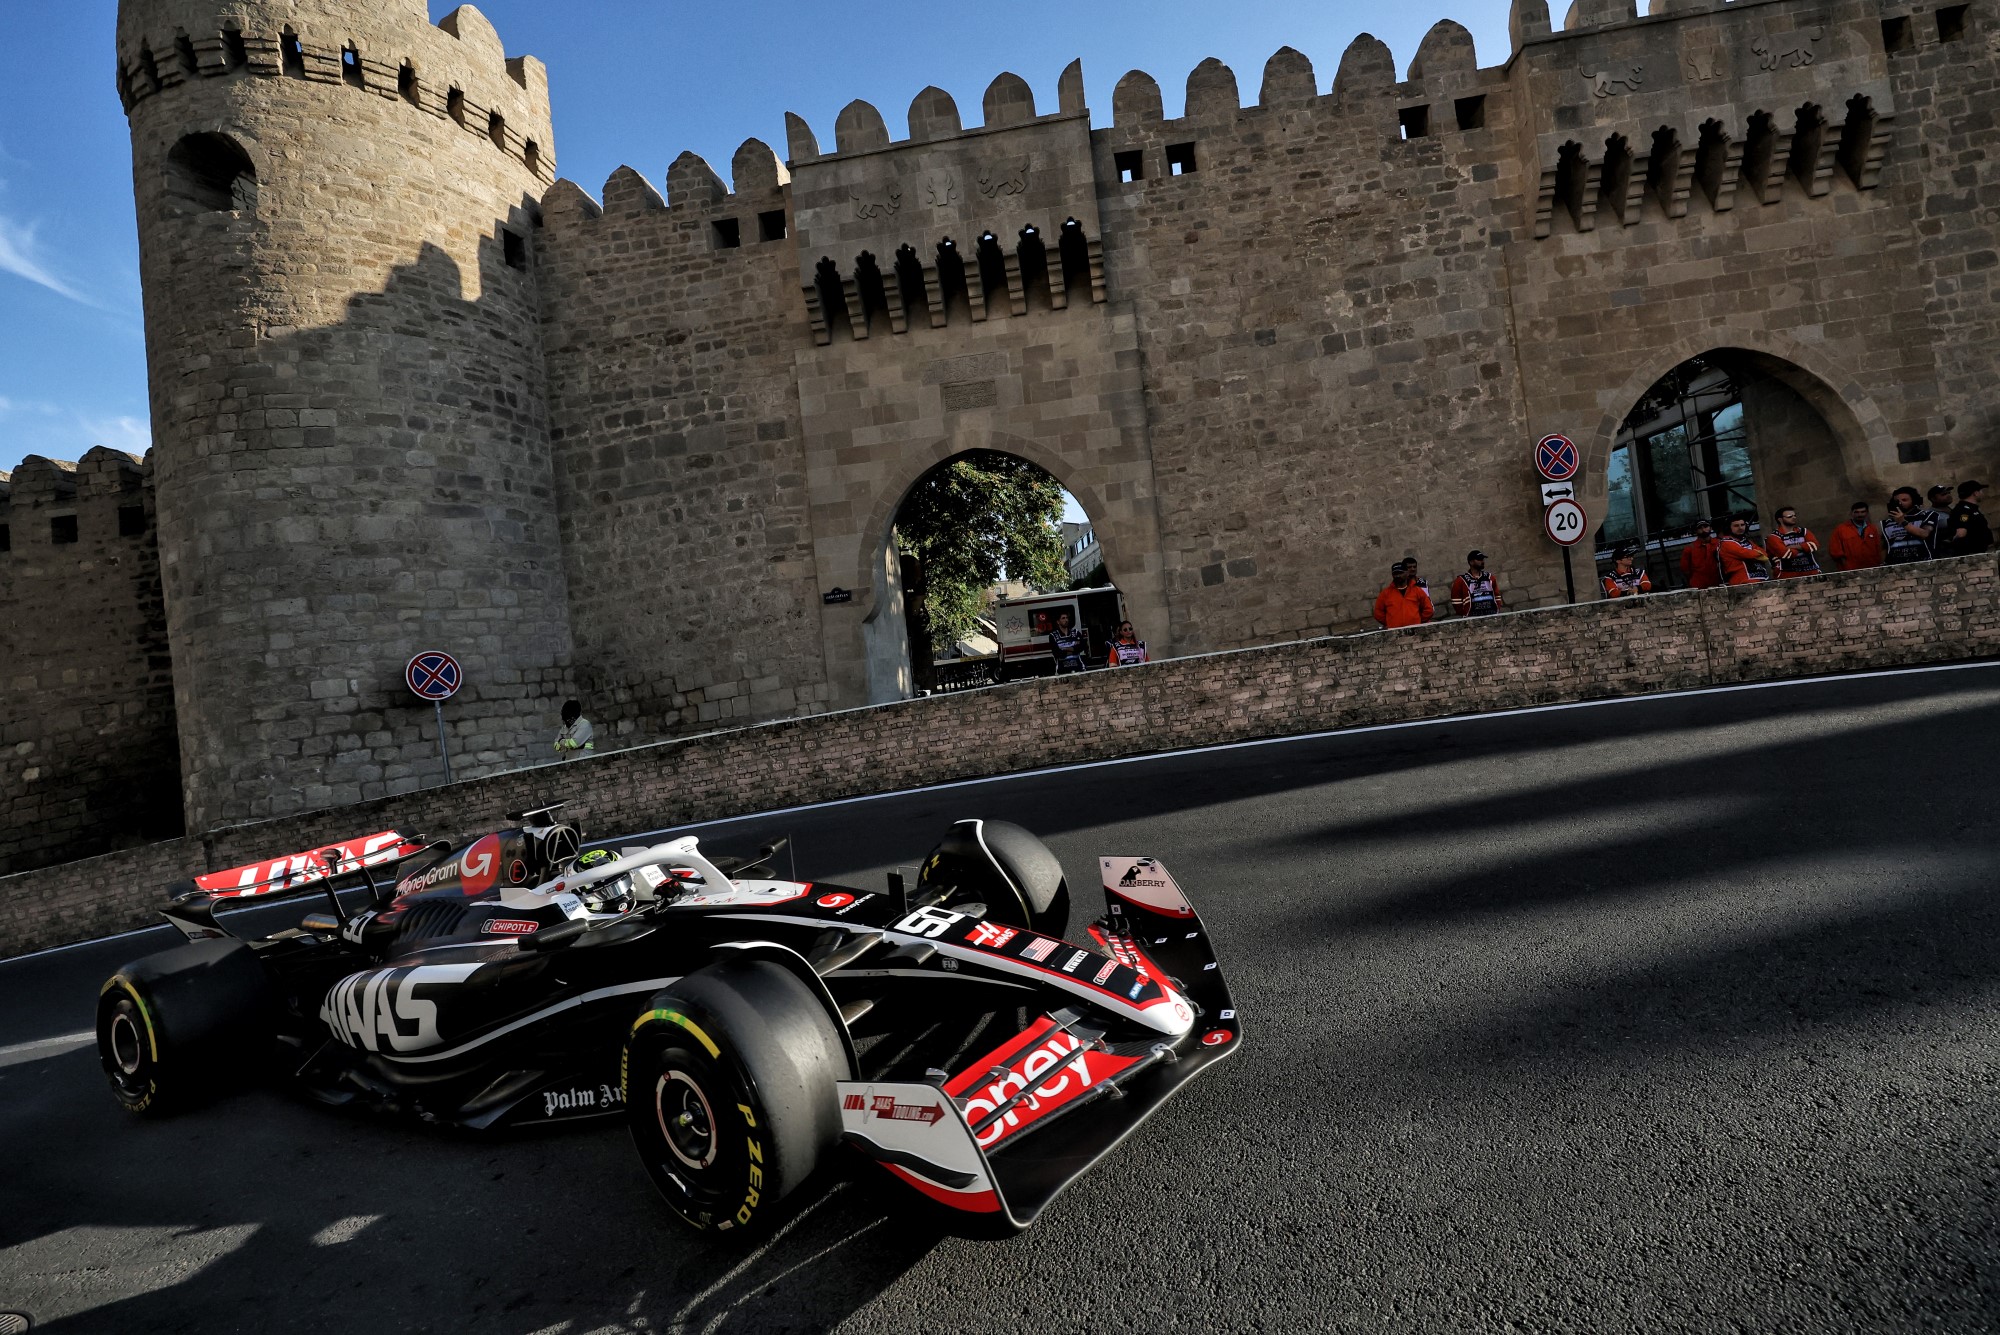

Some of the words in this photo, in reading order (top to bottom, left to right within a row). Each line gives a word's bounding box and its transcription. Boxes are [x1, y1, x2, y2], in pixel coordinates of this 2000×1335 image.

[1555, 512, 1578, 531] 20
[396, 861, 458, 897] MoneyGram
[1119, 879, 1166, 888] OAKBERRY
[493, 922, 535, 933] CHIPOTLE
[893, 905, 966, 938] 50
[1062, 949, 1089, 973] PIRELLI
[320, 962, 487, 1052] HAAS
[543, 1087, 596, 1116] Palm
[875, 1098, 893, 1110] HAAS
[737, 1102, 757, 1128] P
[736, 1136, 763, 1225] ZERO
